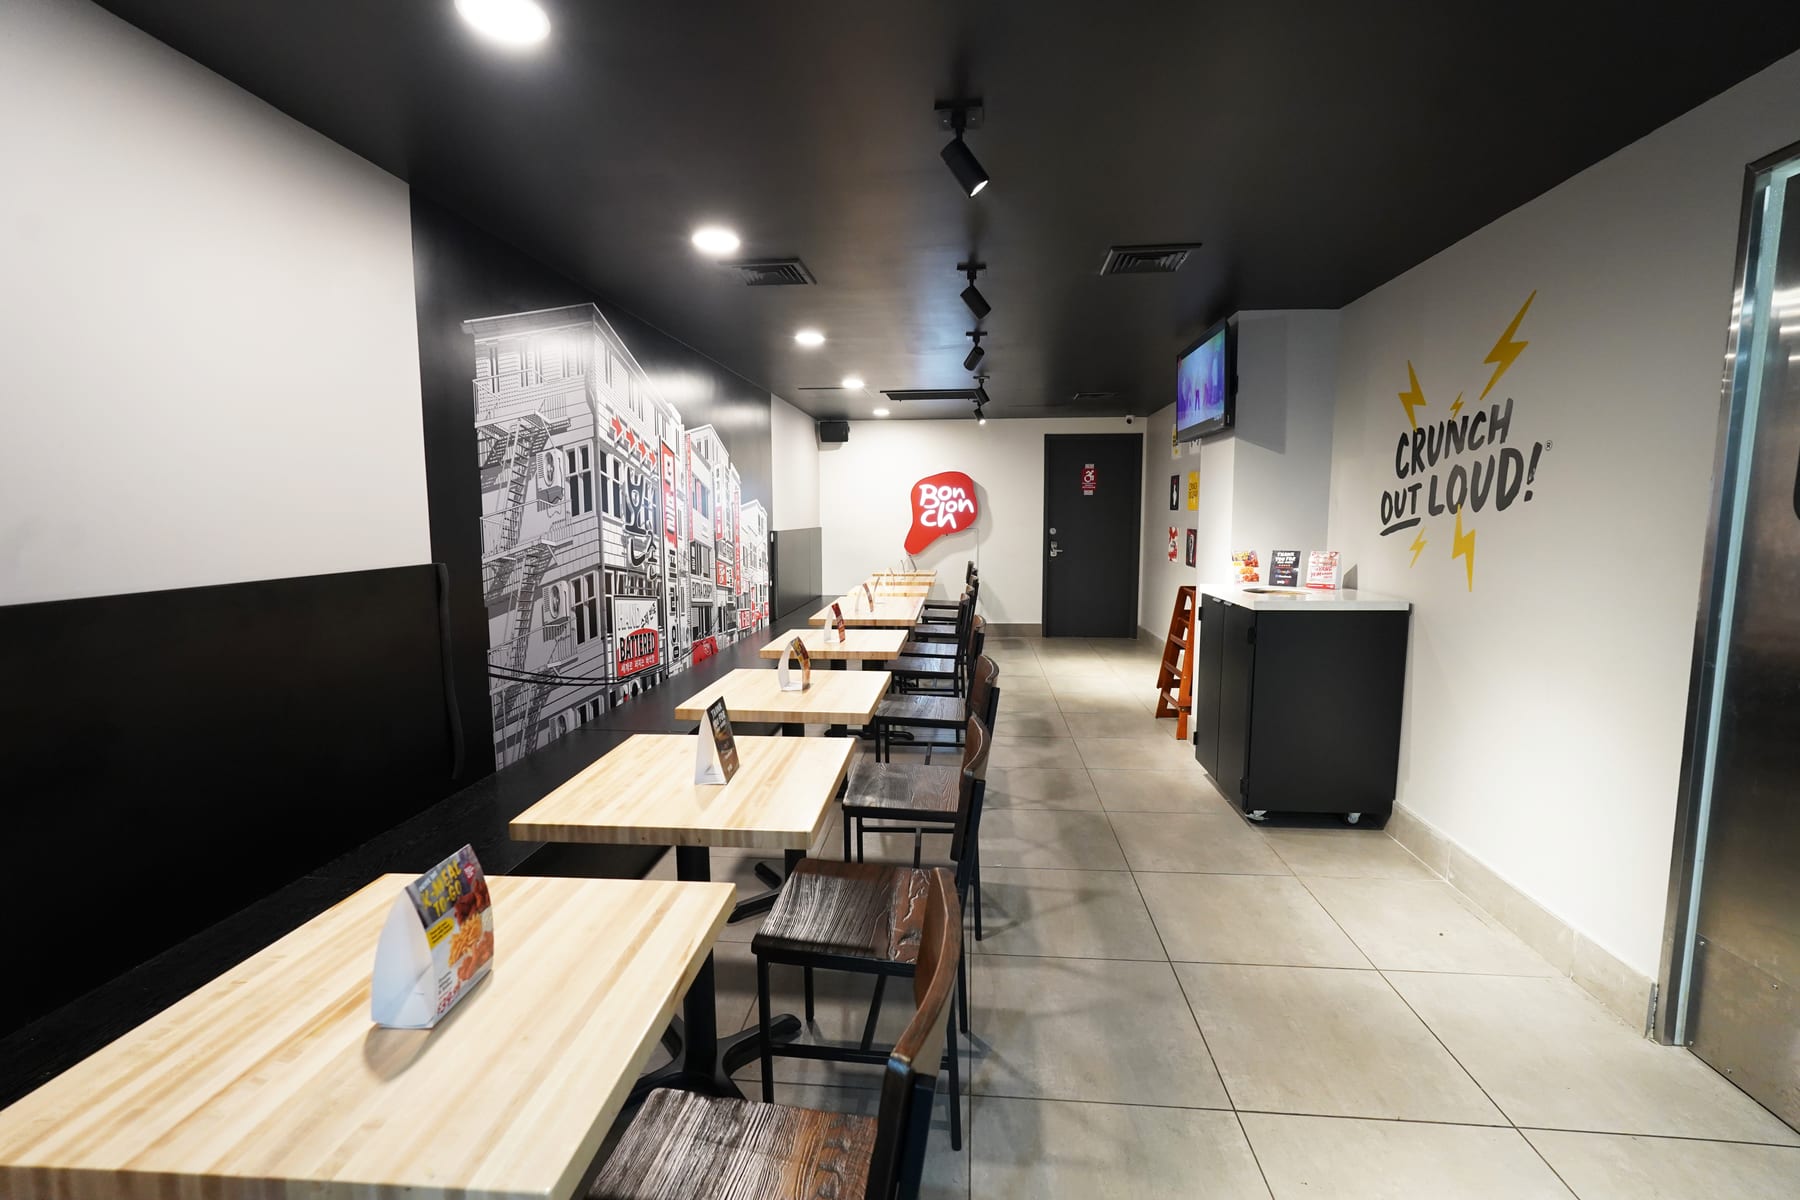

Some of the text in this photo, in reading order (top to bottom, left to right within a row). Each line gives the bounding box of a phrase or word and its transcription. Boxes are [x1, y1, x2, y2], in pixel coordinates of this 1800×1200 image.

[1395, 398, 1514, 479] CRUNCH
[1380, 441, 1543, 525] OUT LOUD!
[619, 632, 655, 663] BATTERED
[432, 879, 462, 917] TO-GO
